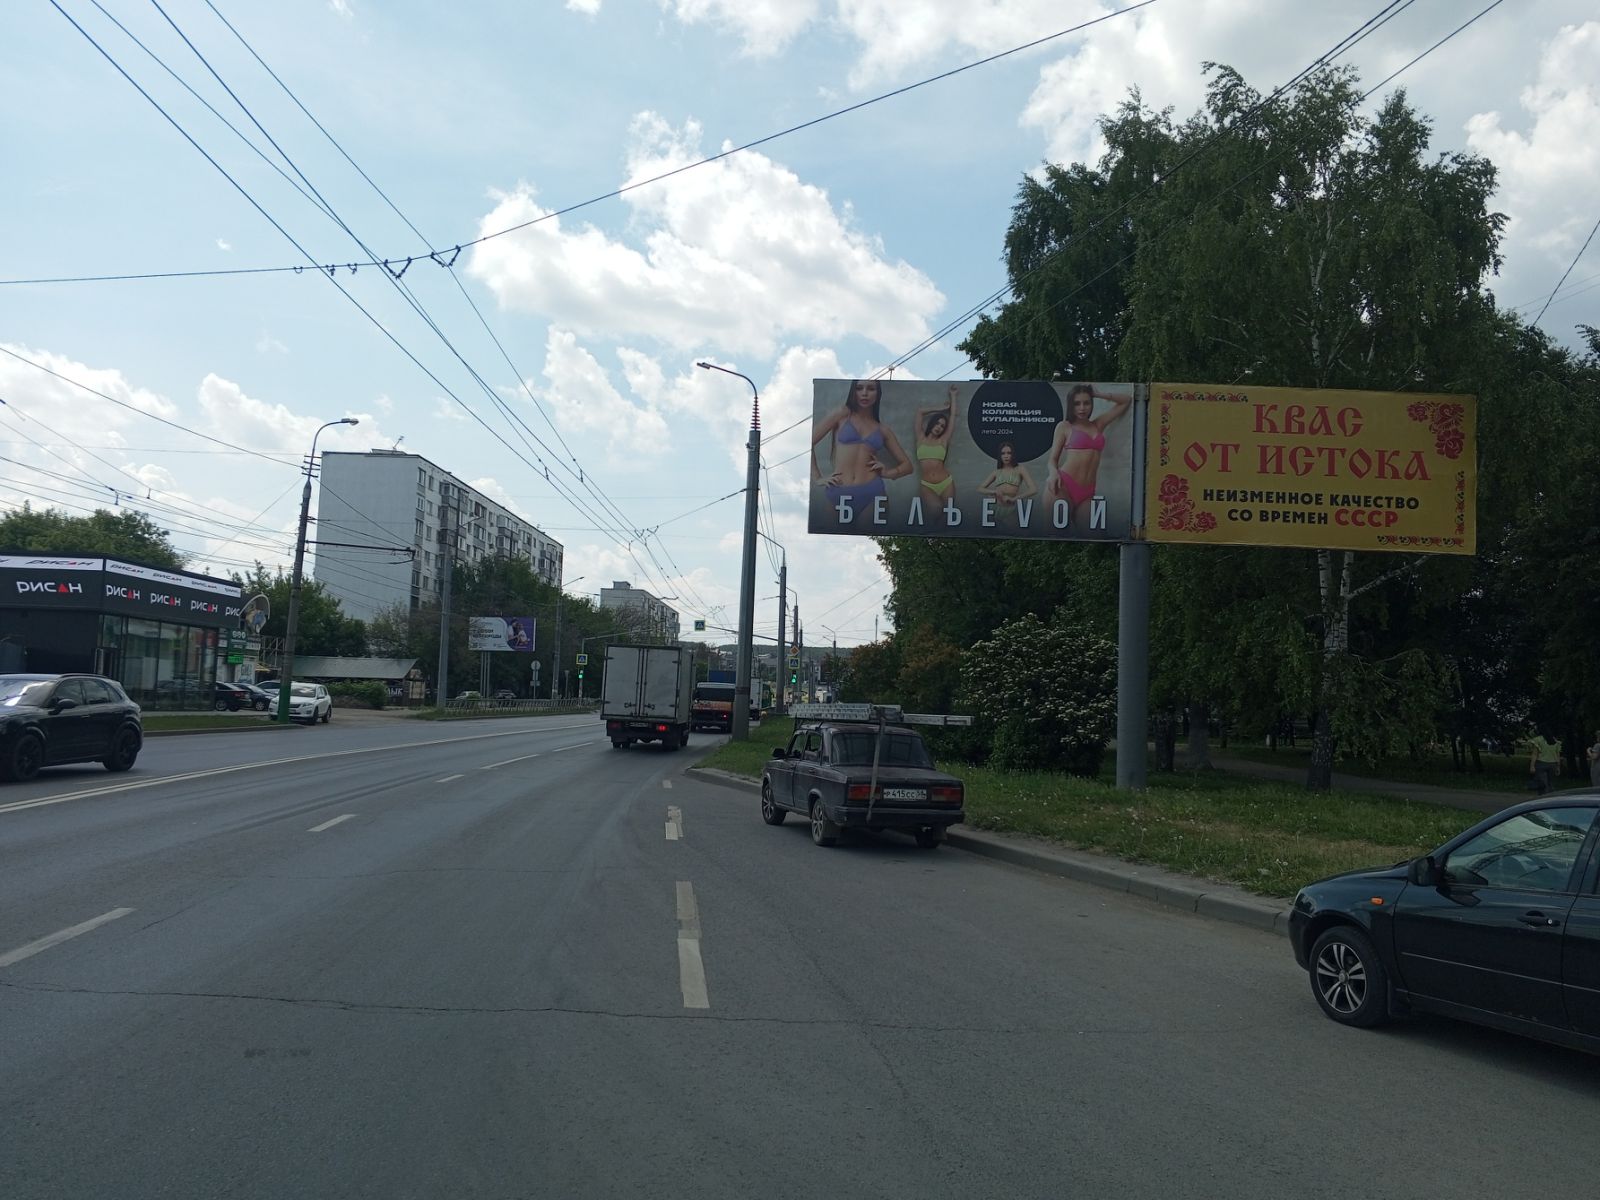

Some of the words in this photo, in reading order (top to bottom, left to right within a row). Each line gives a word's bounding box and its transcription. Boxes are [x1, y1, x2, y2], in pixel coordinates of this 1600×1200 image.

[1252, 403, 1364, 437] КВАС
[1183, 441, 1241, 473] ОТ
[1257, 444, 1432, 481] ИСТОКА
[1203, 488, 1323, 506] НЕИЗМЕННОЕ
[1329, 493, 1420, 510] КАЧЕСТВО
[1227, 508, 1253, 522] СО
[1259, 510, 1329, 525] ВРЕМЕН
[1334, 508, 1399, 528] СССР
